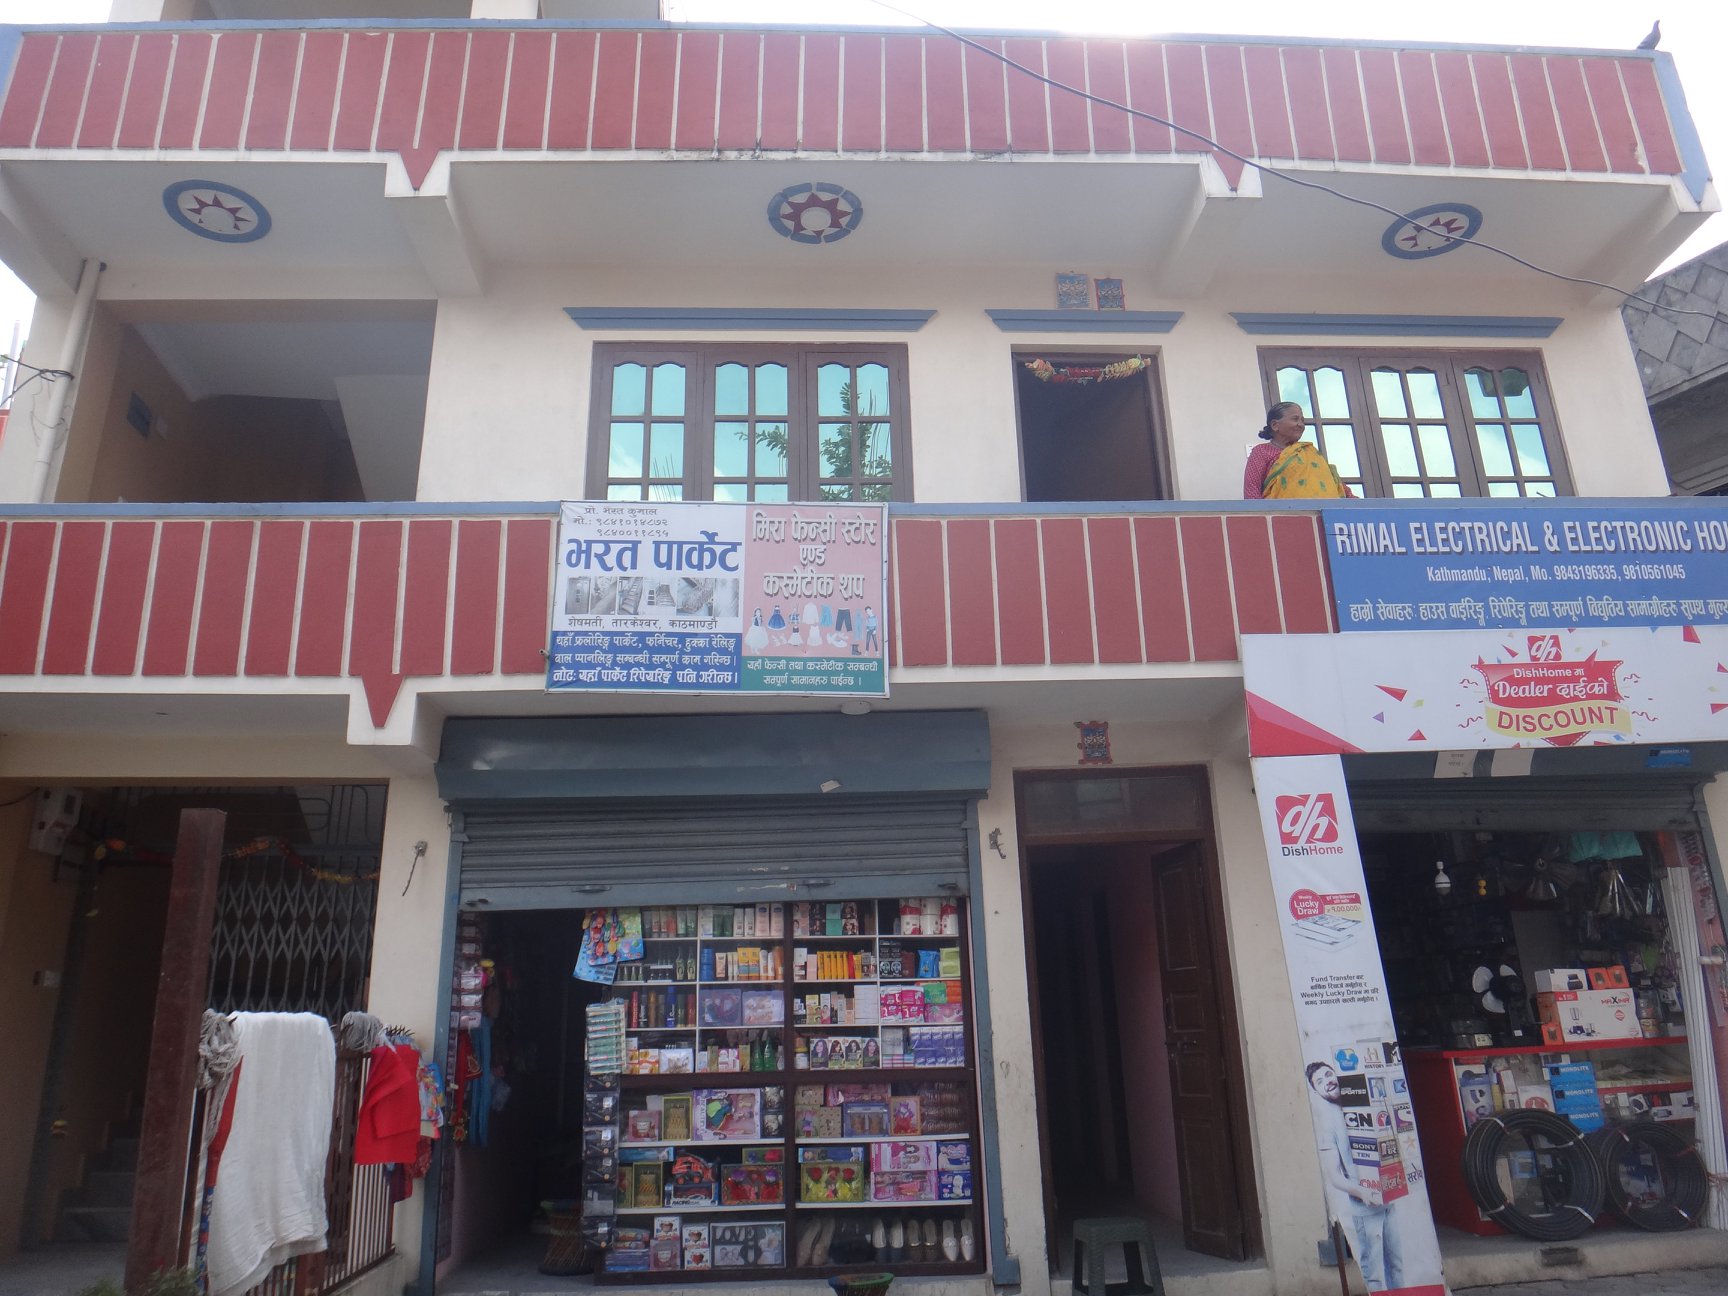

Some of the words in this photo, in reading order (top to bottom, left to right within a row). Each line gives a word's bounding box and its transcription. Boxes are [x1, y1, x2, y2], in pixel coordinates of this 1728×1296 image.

[752, 508, 787, 543] मिरा
[791, 510, 838, 545] फेन्सी
[840, 511, 877, 546] स्टोर
[1334, 521, 1407, 554] RIMAL
[1409, 521, 1539, 554] ELECTRICAL
[1543, 520, 1561, 552] &
[1562, 520, 1692, 552] ELECTRONIC
[565, 538, 642, 572] भरत
[652, 530, 742, 572] पार्केट
[799, 544, 827, 567] एण्ड
[1427, 566, 1492, 583] Kathmandu,
[1493, 565, 1529, 584] Nepal,
[1530, 565, 1551, 580] Mo.
[1554, 565, 1622, 582] 9843196335,
[1623, 564, 1686, 580] 9810561045
[839, 574, 865, 601] शप
[1349, 599, 1374, 622] हाम्रो
[1419, 602, 1447, 620] हाउस
[1529, 601, 1549, 618] तथा
[1551, 597, 1585, 622] सम्पूर्ण
[556, 632, 572, 647] यहाँ
[681, 655, 701, 665] काम
[789, 661, 803, 670] तथा
[676, 668, 697, 683] पनि
[1513, 667, 1572, 678] DishHome
[1573, 668, 1585, 677] मा
[1495, 681, 1552, 698] Dealer
[1497, 706, 1618, 732] DISCOUNT
[1281, 845, 1344, 857] DishHome
[1293, 900, 1319, 909] Lucky
[1297, 907, 1319, 915] Draw
[1329, 974, 1355, 982] Transfer
[1352, 1143, 1376, 1151] SONY
